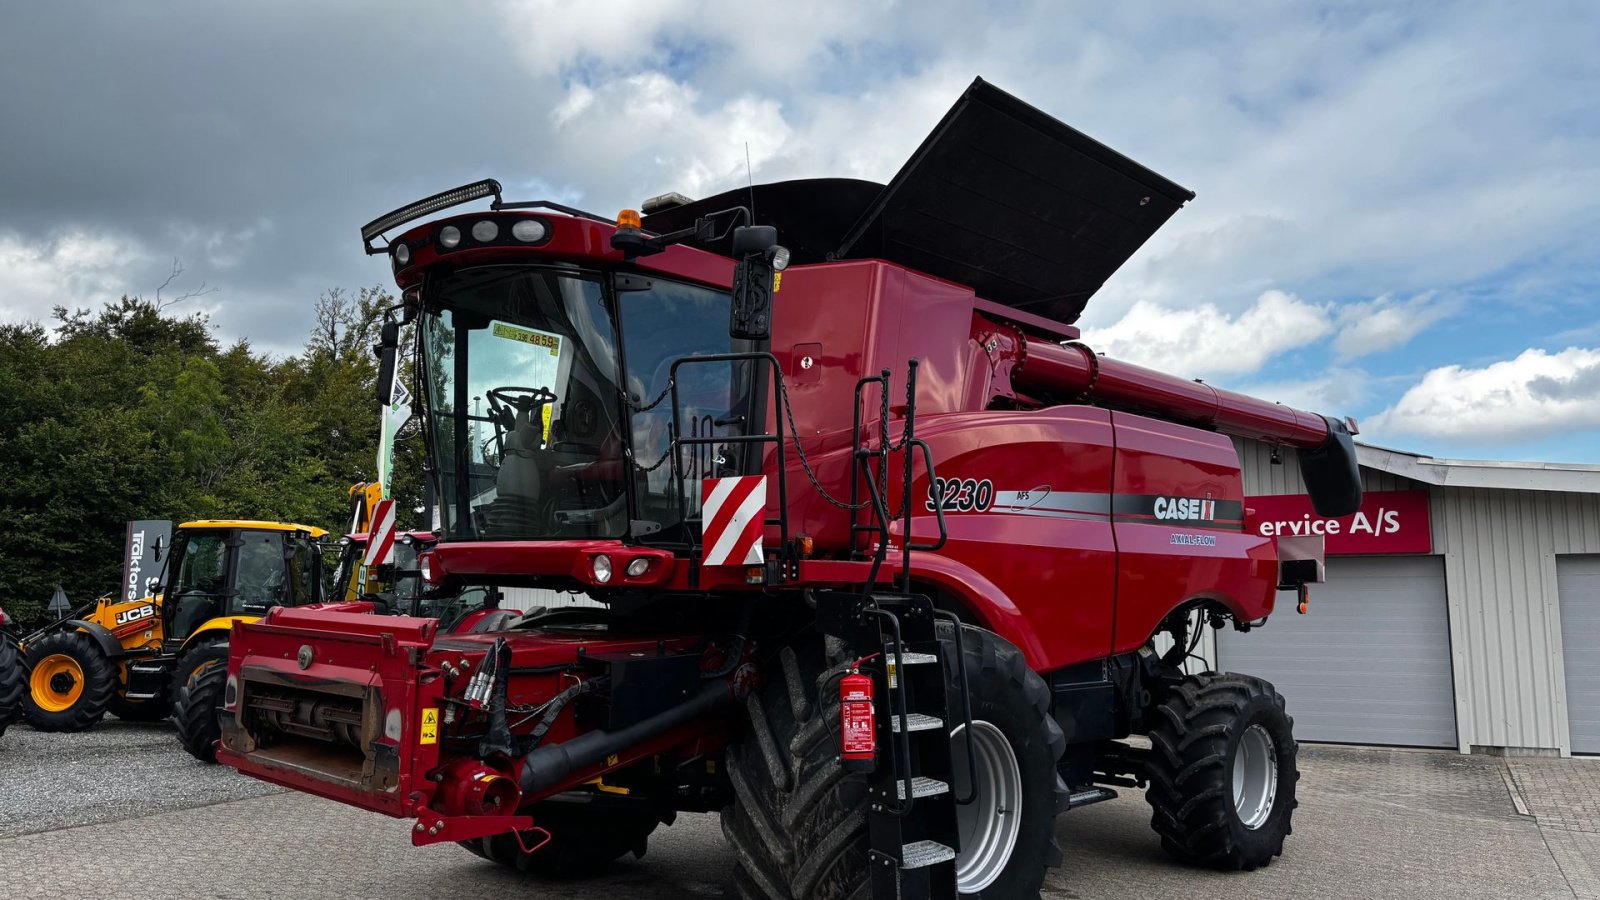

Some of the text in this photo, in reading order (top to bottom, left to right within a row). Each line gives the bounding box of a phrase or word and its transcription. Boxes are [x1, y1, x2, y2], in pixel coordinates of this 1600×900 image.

[925, 477, 993, 512] 9230
[1016, 490, 1030, 500] AFS
[1153, 496, 1200, 520] CASE
[1259, 507, 1401, 537] ervice A/S
[1170, 533, 1216, 546] AXIAL-FLOW
[127, 530, 145, 602] Traktors
[117, 605, 154, 624] JCB
